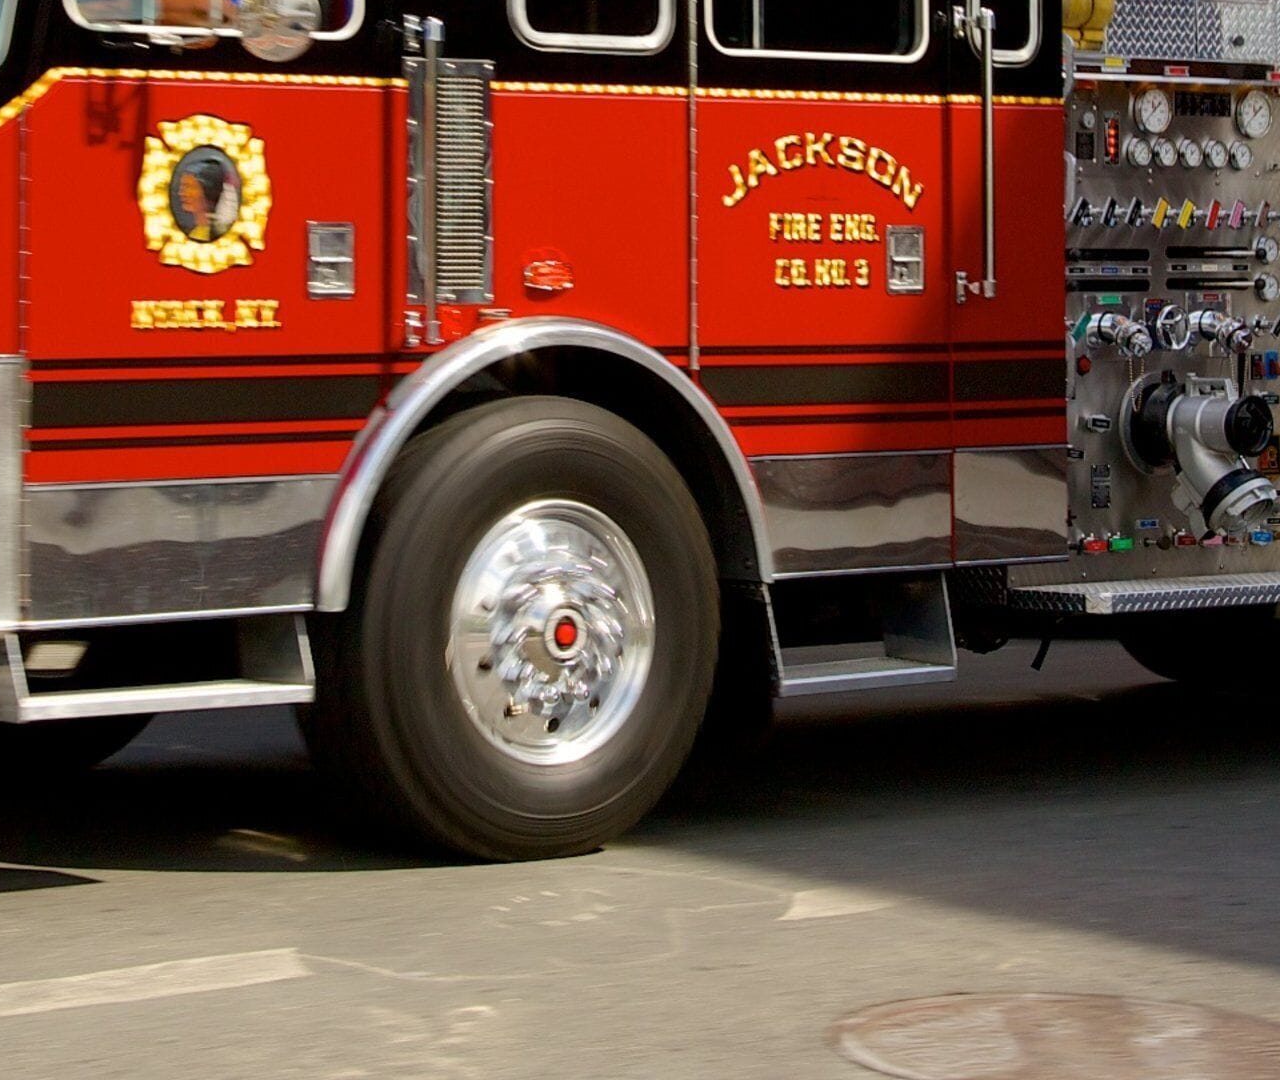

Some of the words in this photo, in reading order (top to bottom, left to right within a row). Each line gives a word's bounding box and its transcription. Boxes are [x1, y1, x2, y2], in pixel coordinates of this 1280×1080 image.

[721, 132, 924, 208] JACKSON
[769, 212, 822, 240] FIRE
[829, 213, 880, 241] ENG.
[815, 258, 851, 286] NO.
[854, 258, 869, 286] 3
